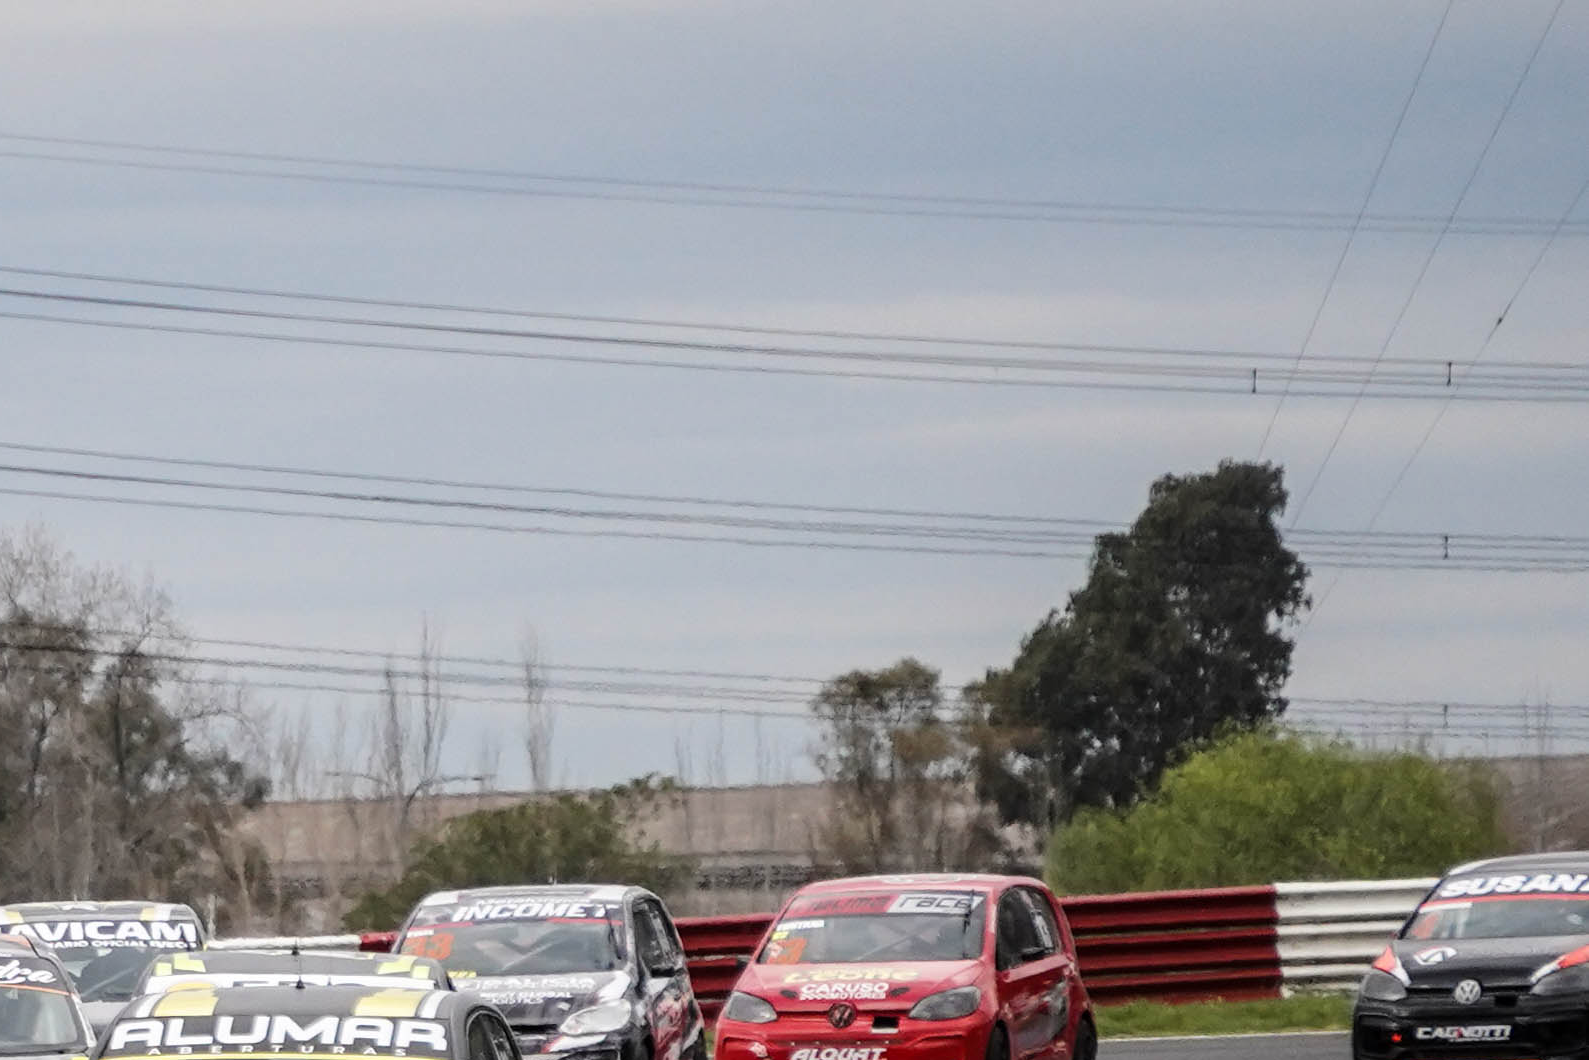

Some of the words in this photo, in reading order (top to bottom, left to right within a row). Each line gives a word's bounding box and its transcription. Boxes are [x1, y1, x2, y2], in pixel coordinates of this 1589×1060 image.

[1439, 874, 1589, 897] SUSAN
[800, 983, 889, 995] CARUSO
[111, 1015, 448, 1050] ALUMAR
[148, 1045, 407, 1056] ABERTURAS
